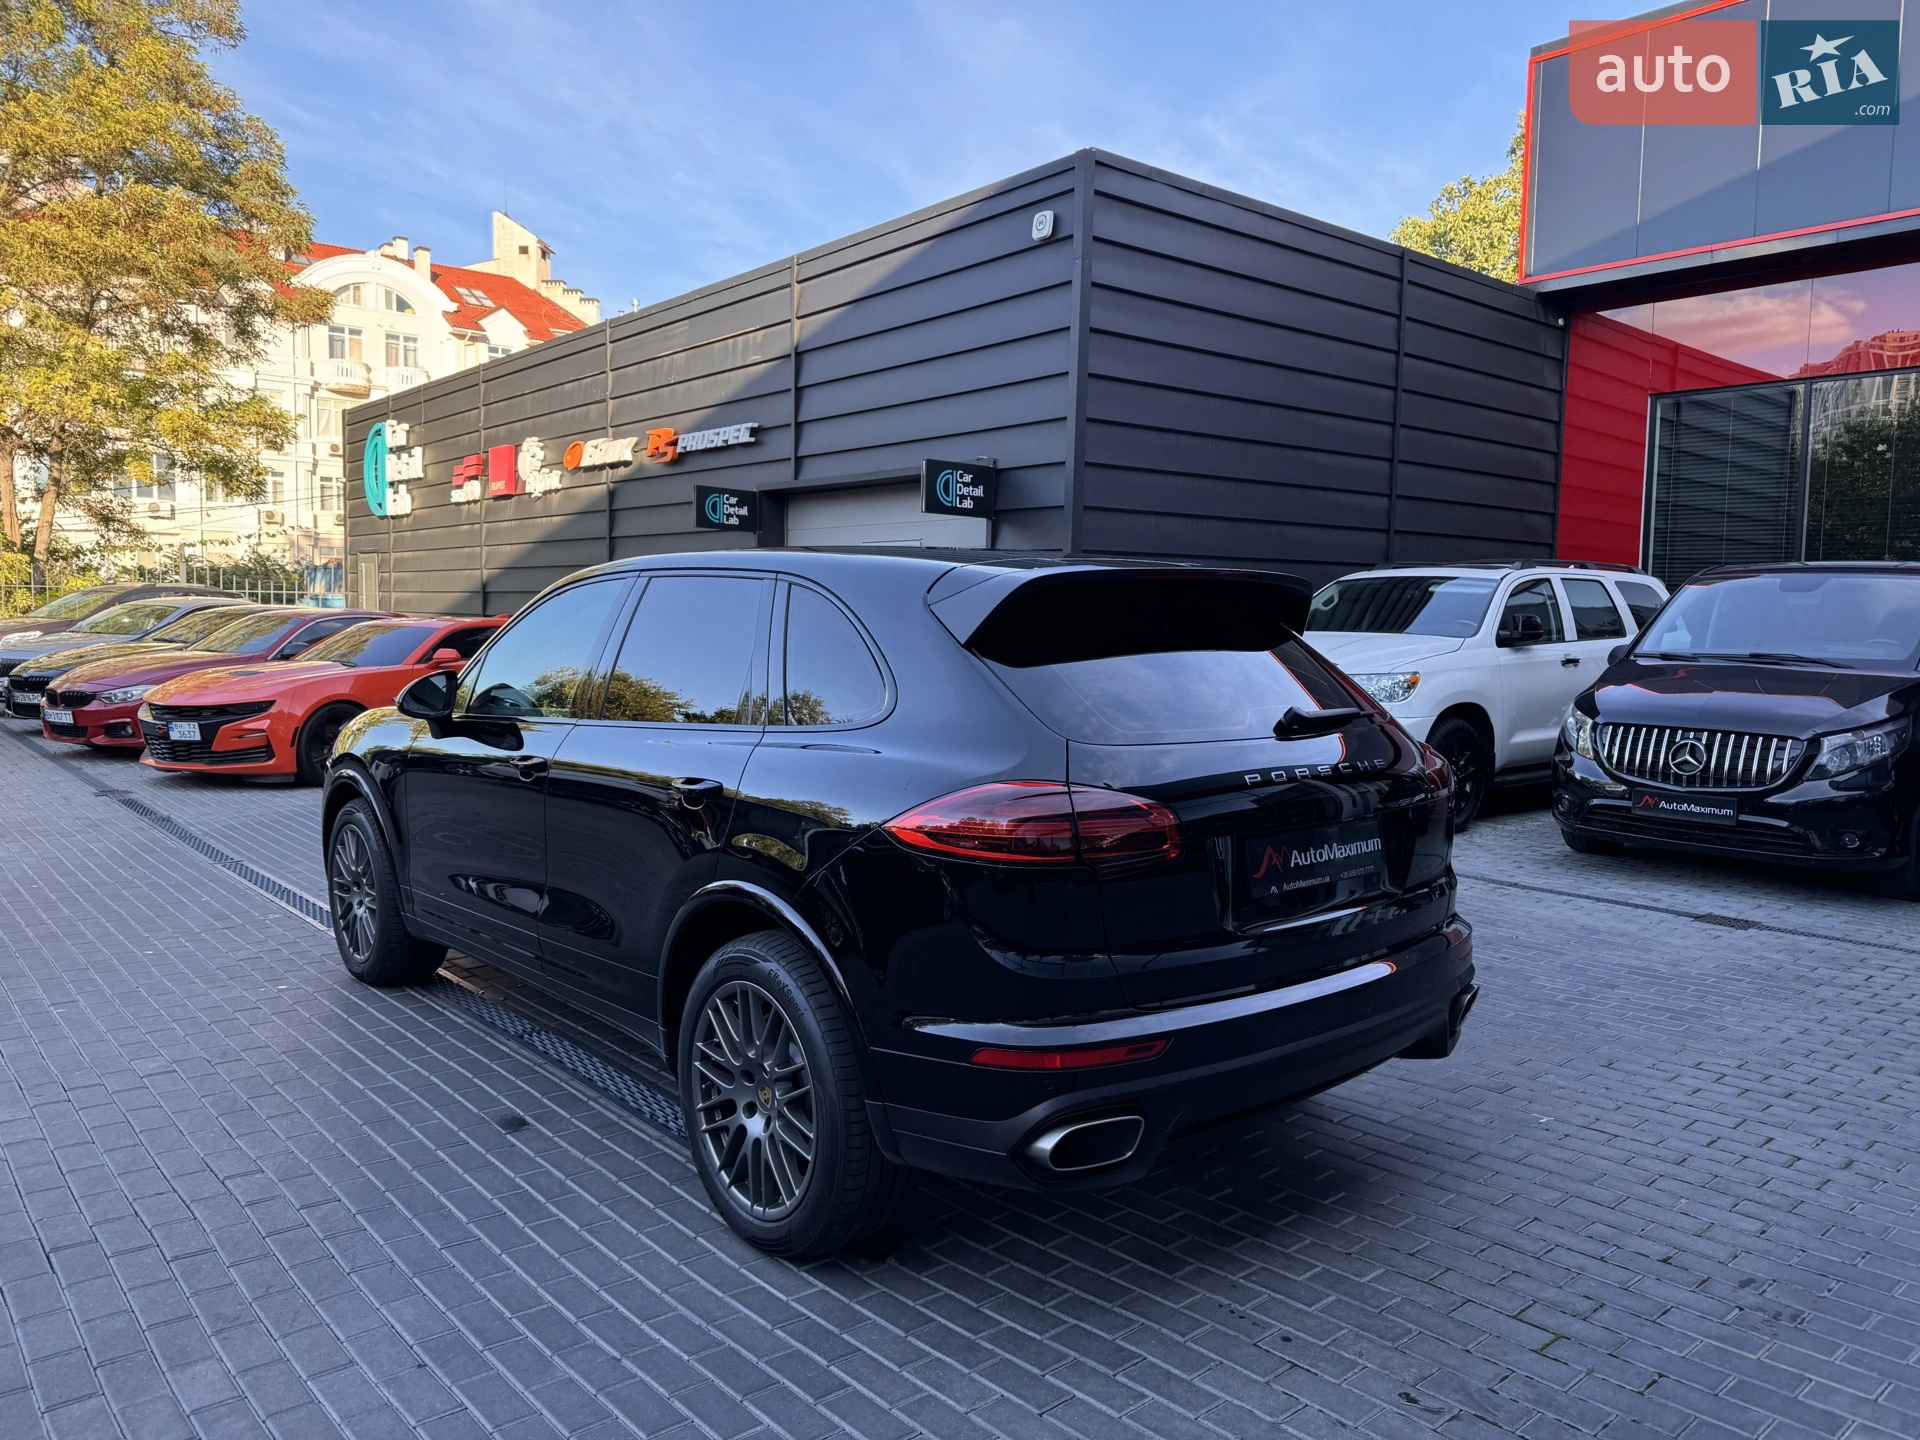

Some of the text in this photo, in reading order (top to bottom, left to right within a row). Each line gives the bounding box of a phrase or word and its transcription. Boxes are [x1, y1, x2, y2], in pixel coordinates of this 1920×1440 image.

[676, 422, 759, 453] PROSPEC
[956, 470, 974, 483] Car
[956, 483, 984, 497] Detail
[386, 484, 412, 515] Lab
[723, 494, 739, 505] Car
[956, 496, 974, 509] Lab
[723, 504, 749, 516] Detail
[723, 514, 740, 525] Lab
[177, 730, 196, 739] 3637
[1244, 758, 1387, 786] PORSCHE
[1658, 800, 1734, 816] AutoMaximum
[1290, 837, 1382, 868] AutoMaximum
